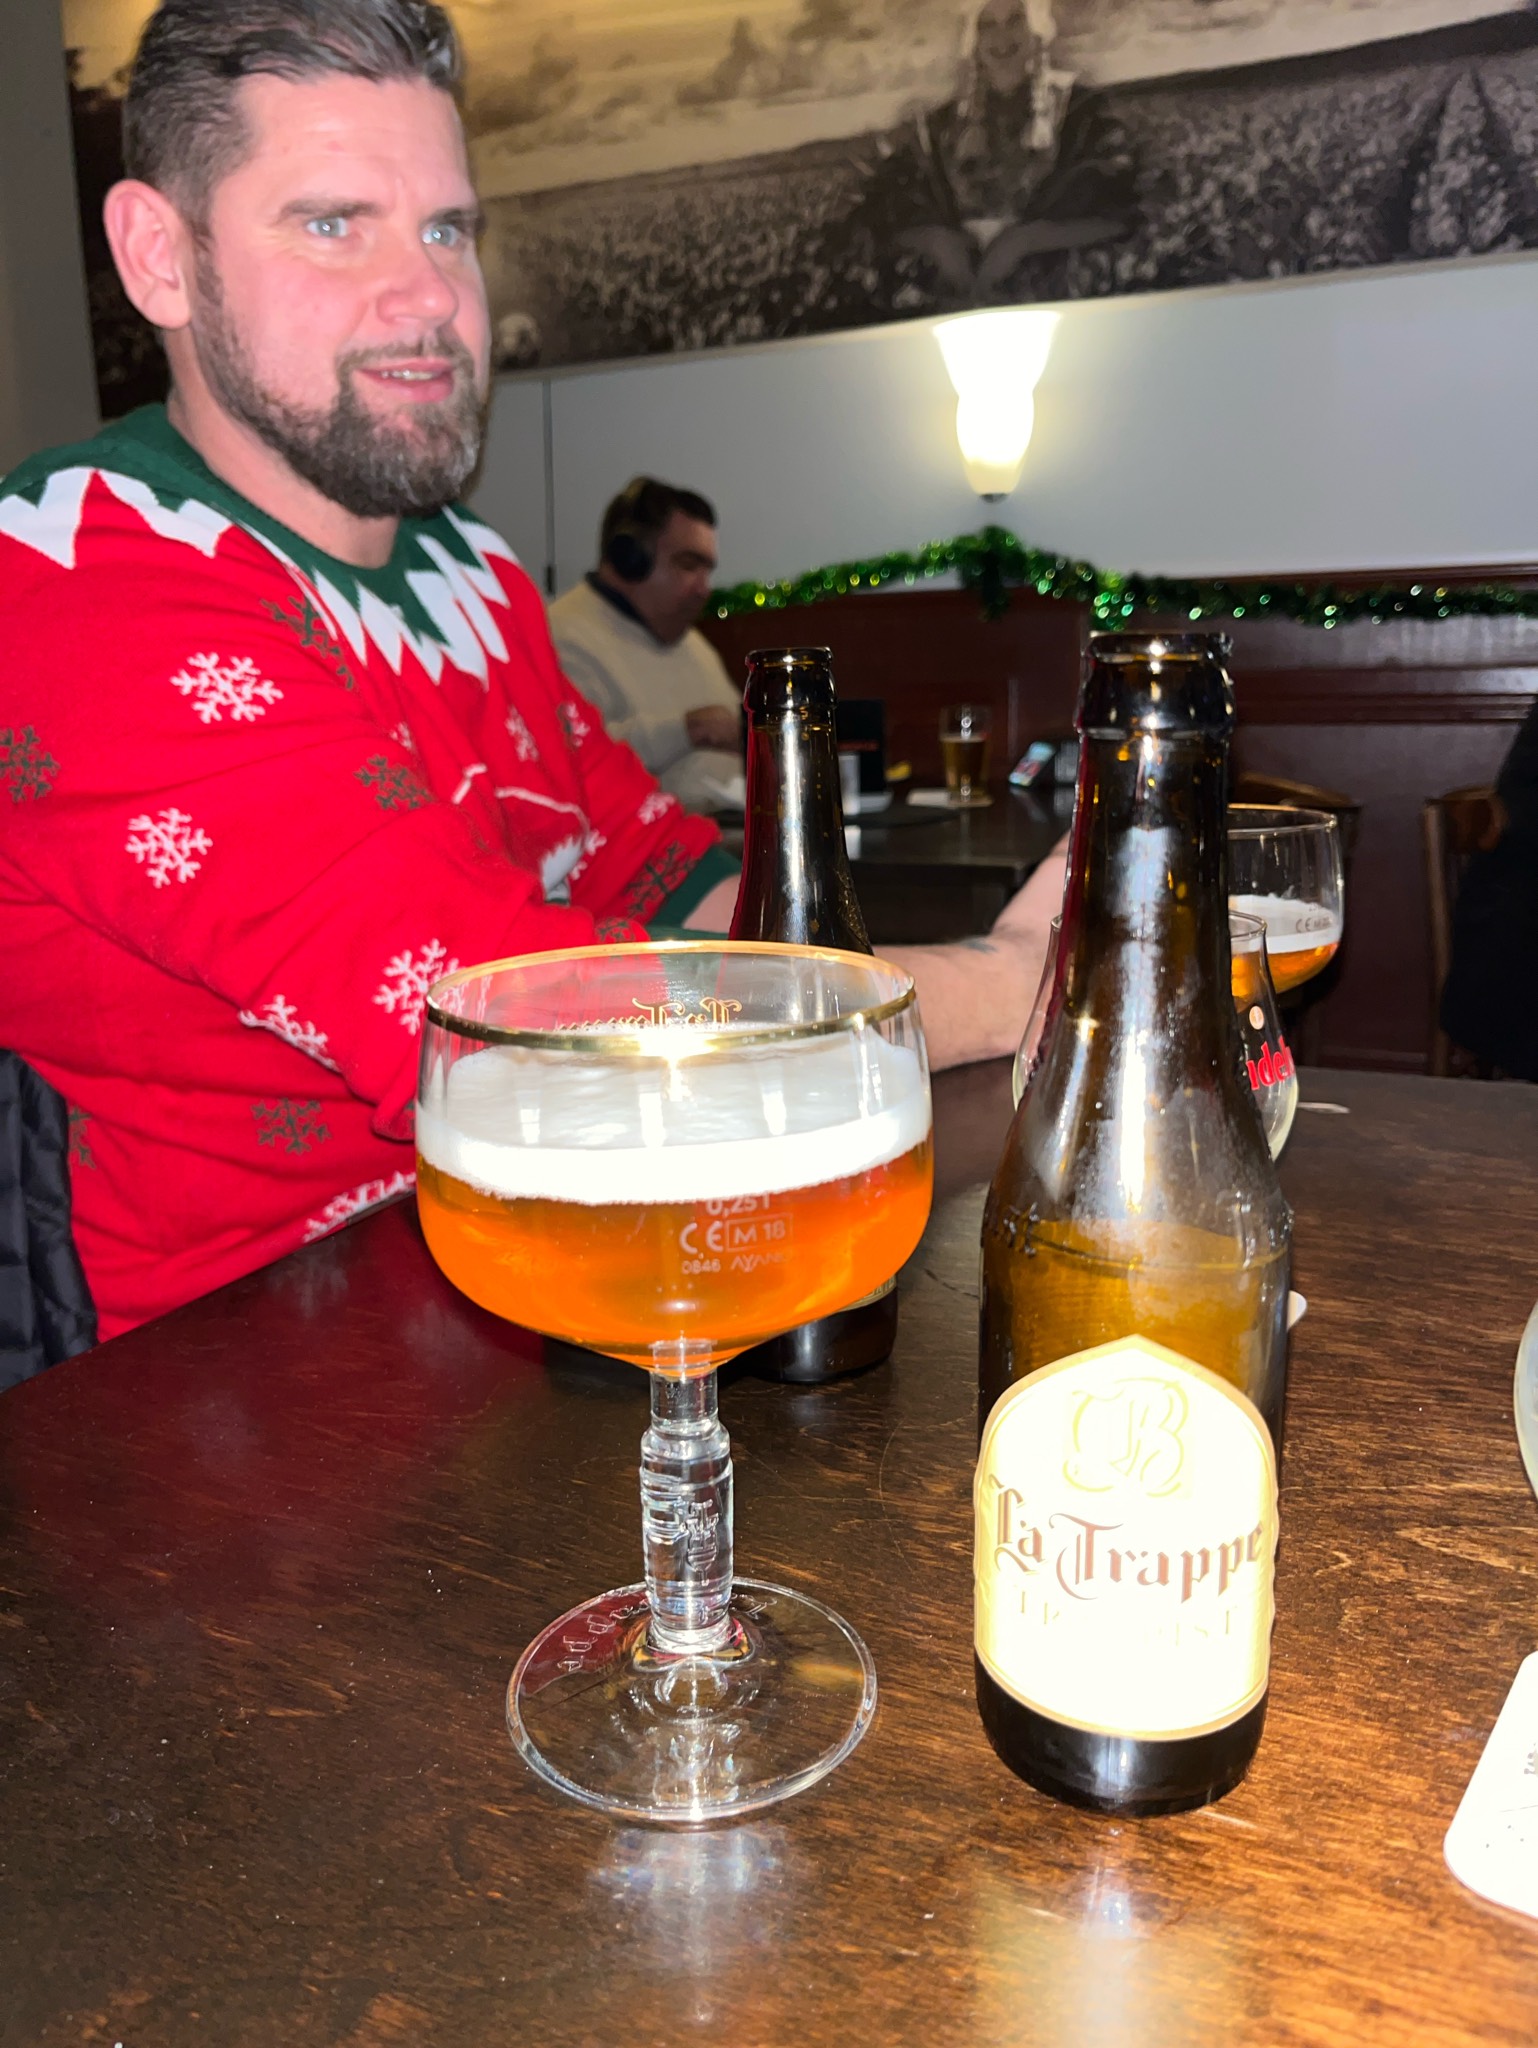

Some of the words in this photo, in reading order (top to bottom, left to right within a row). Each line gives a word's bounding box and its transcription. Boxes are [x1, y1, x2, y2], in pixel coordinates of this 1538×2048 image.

[734, 1224, 758, 1245] M
[764, 1219, 786, 1241] 18
[988, 1473, 1045, 1573] La
[1049, 1512, 1263, 1604] Trappe
